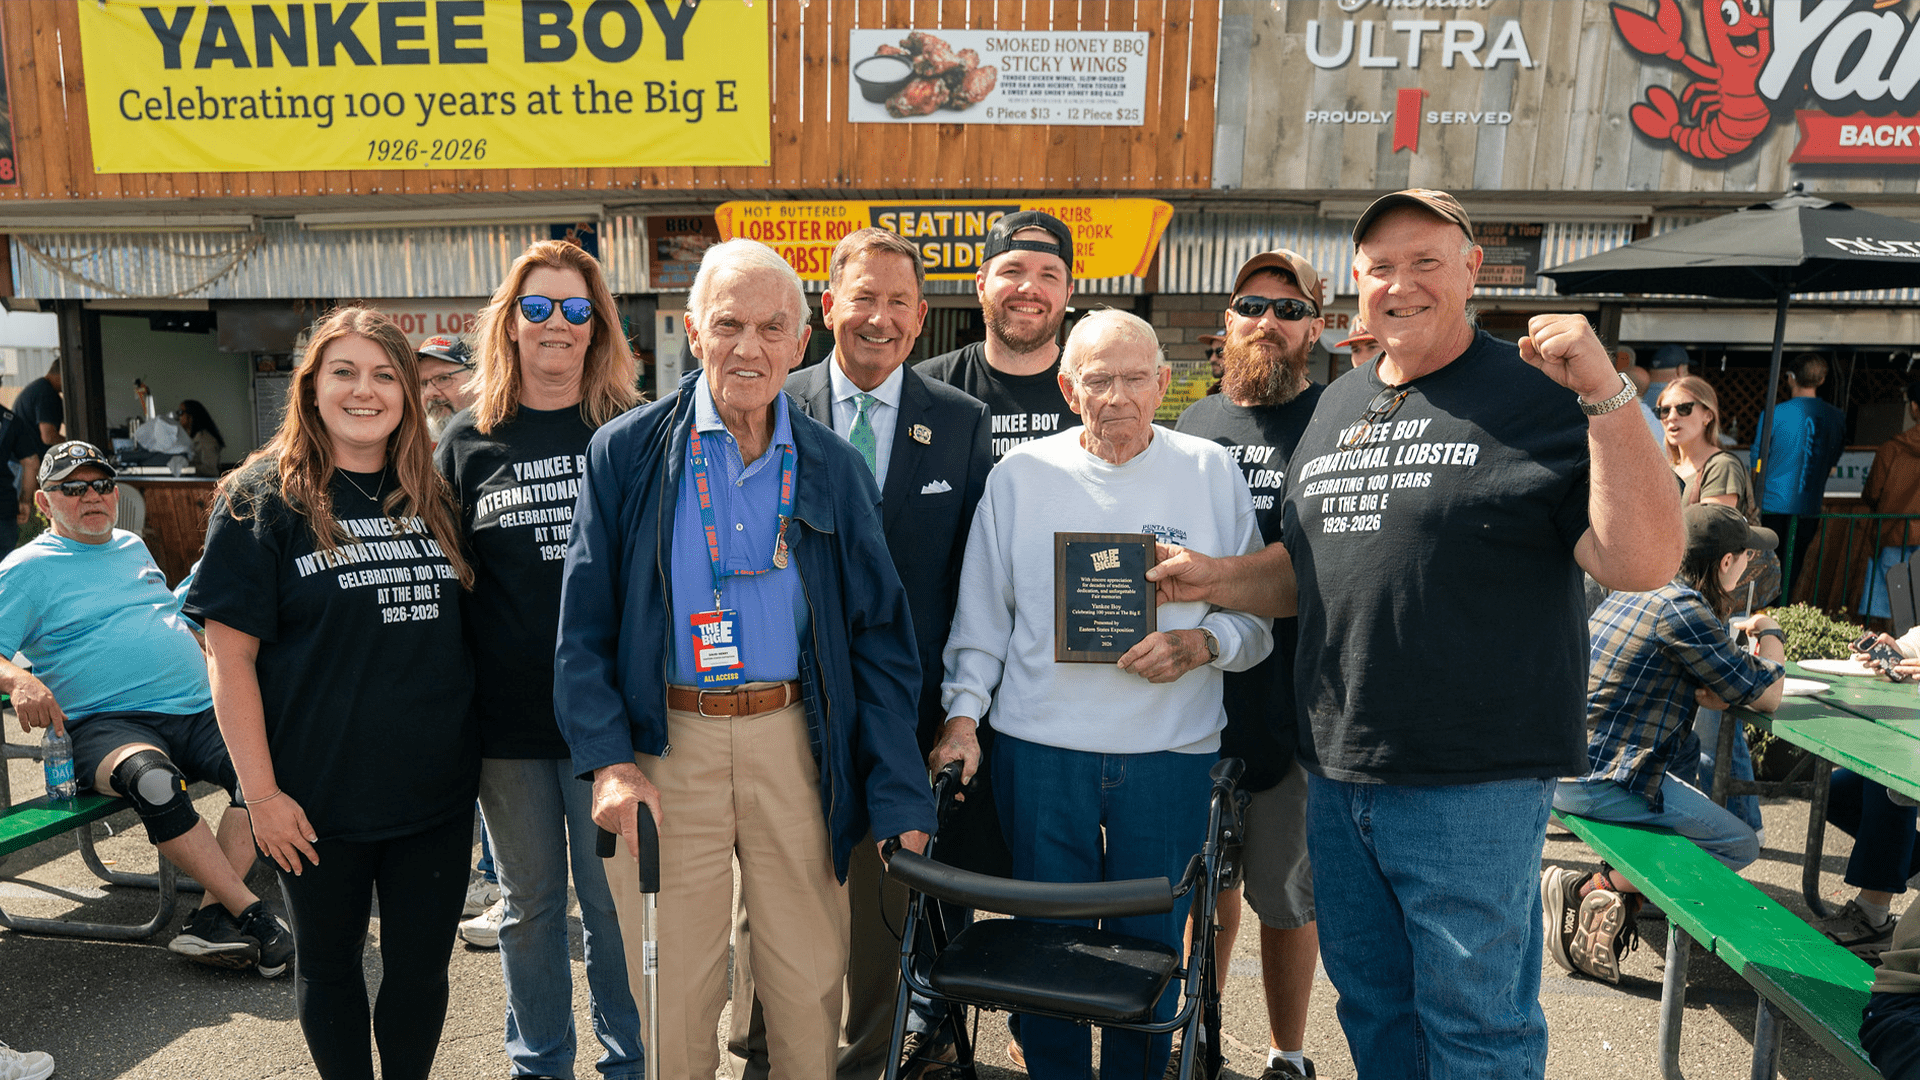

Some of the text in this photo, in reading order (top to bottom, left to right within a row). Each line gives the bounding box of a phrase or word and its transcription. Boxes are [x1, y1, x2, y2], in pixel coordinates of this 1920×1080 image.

[139, 0, 700, 69] YANKEE BOY
[1305, 20, 1533, 68] ULTRA
[985, 37, 1144, 56] SMOKED HONEY BBQ
[1001, 56, 1127, 73] STICKY WINGS
[118, 79, 738, 128] Celebrating 100 years at the Big E
[986, 107, 1139, 121] 6 Piece $13 12 Piece $25
[1306, 111, 1513, 124] PROUDLY SERVED
[1839, 125, 1920, 146] BACK
[368, 138, 487, 162] 1926-2026
[744, 205, 847, 218] HOT BUTTERED
[1060, 206, 1093, 222] RIBS
[666, 217, 703, 233] BBQ
[739, 219, 822, 241] LOBSTER
[1077, 224, 1114, 239] PORK
[913, 241, 987, 268] SIDE
[1825, 236, 1920, 253] NÜT
[1031, 413, 1060, 431] BOY
[1391, 418, 1432, 441] BOY
[1243, 445, 1276, 464] BOY
[1299, 443, 1480, 484] INTERNATIONAL LOBSTER
[512, 455, 573, 482] YANKEE
[1247, 469, 1284, 489] LOBS
[1303, 472, 1433, 498] CELEBRATING 100 YEARS
[1322, 493, 1389, 514] AT THE BIG E
[337, 516, 400, 538] YANKEE
[499, 506, 572, 529] CELEBRATING
[1142, 524, 1166, 532] PUNTA
[1322, 514, 1381, 533] 1926-2026
[534, 527, 549, 543] AT
[295, 539, 422, 578] INTERNATIONAL
[1090, 549, 1108, 563] THE
[337, 567, 412, 590] CELEBRATING
[412, 565, 434, 582] 100
[377, 583, 441, 604] AT THE BIG E
[381, 602, 440, 624] 1926-2026
[1110, 603, 1122, 611] Boy
[698, 620, 733, 643] THE E
[701, 633, 722, 646] BIG
[703, 672, 739, 683] ALL ACCESS
[1563, 907, 1576, 934] HOKA
